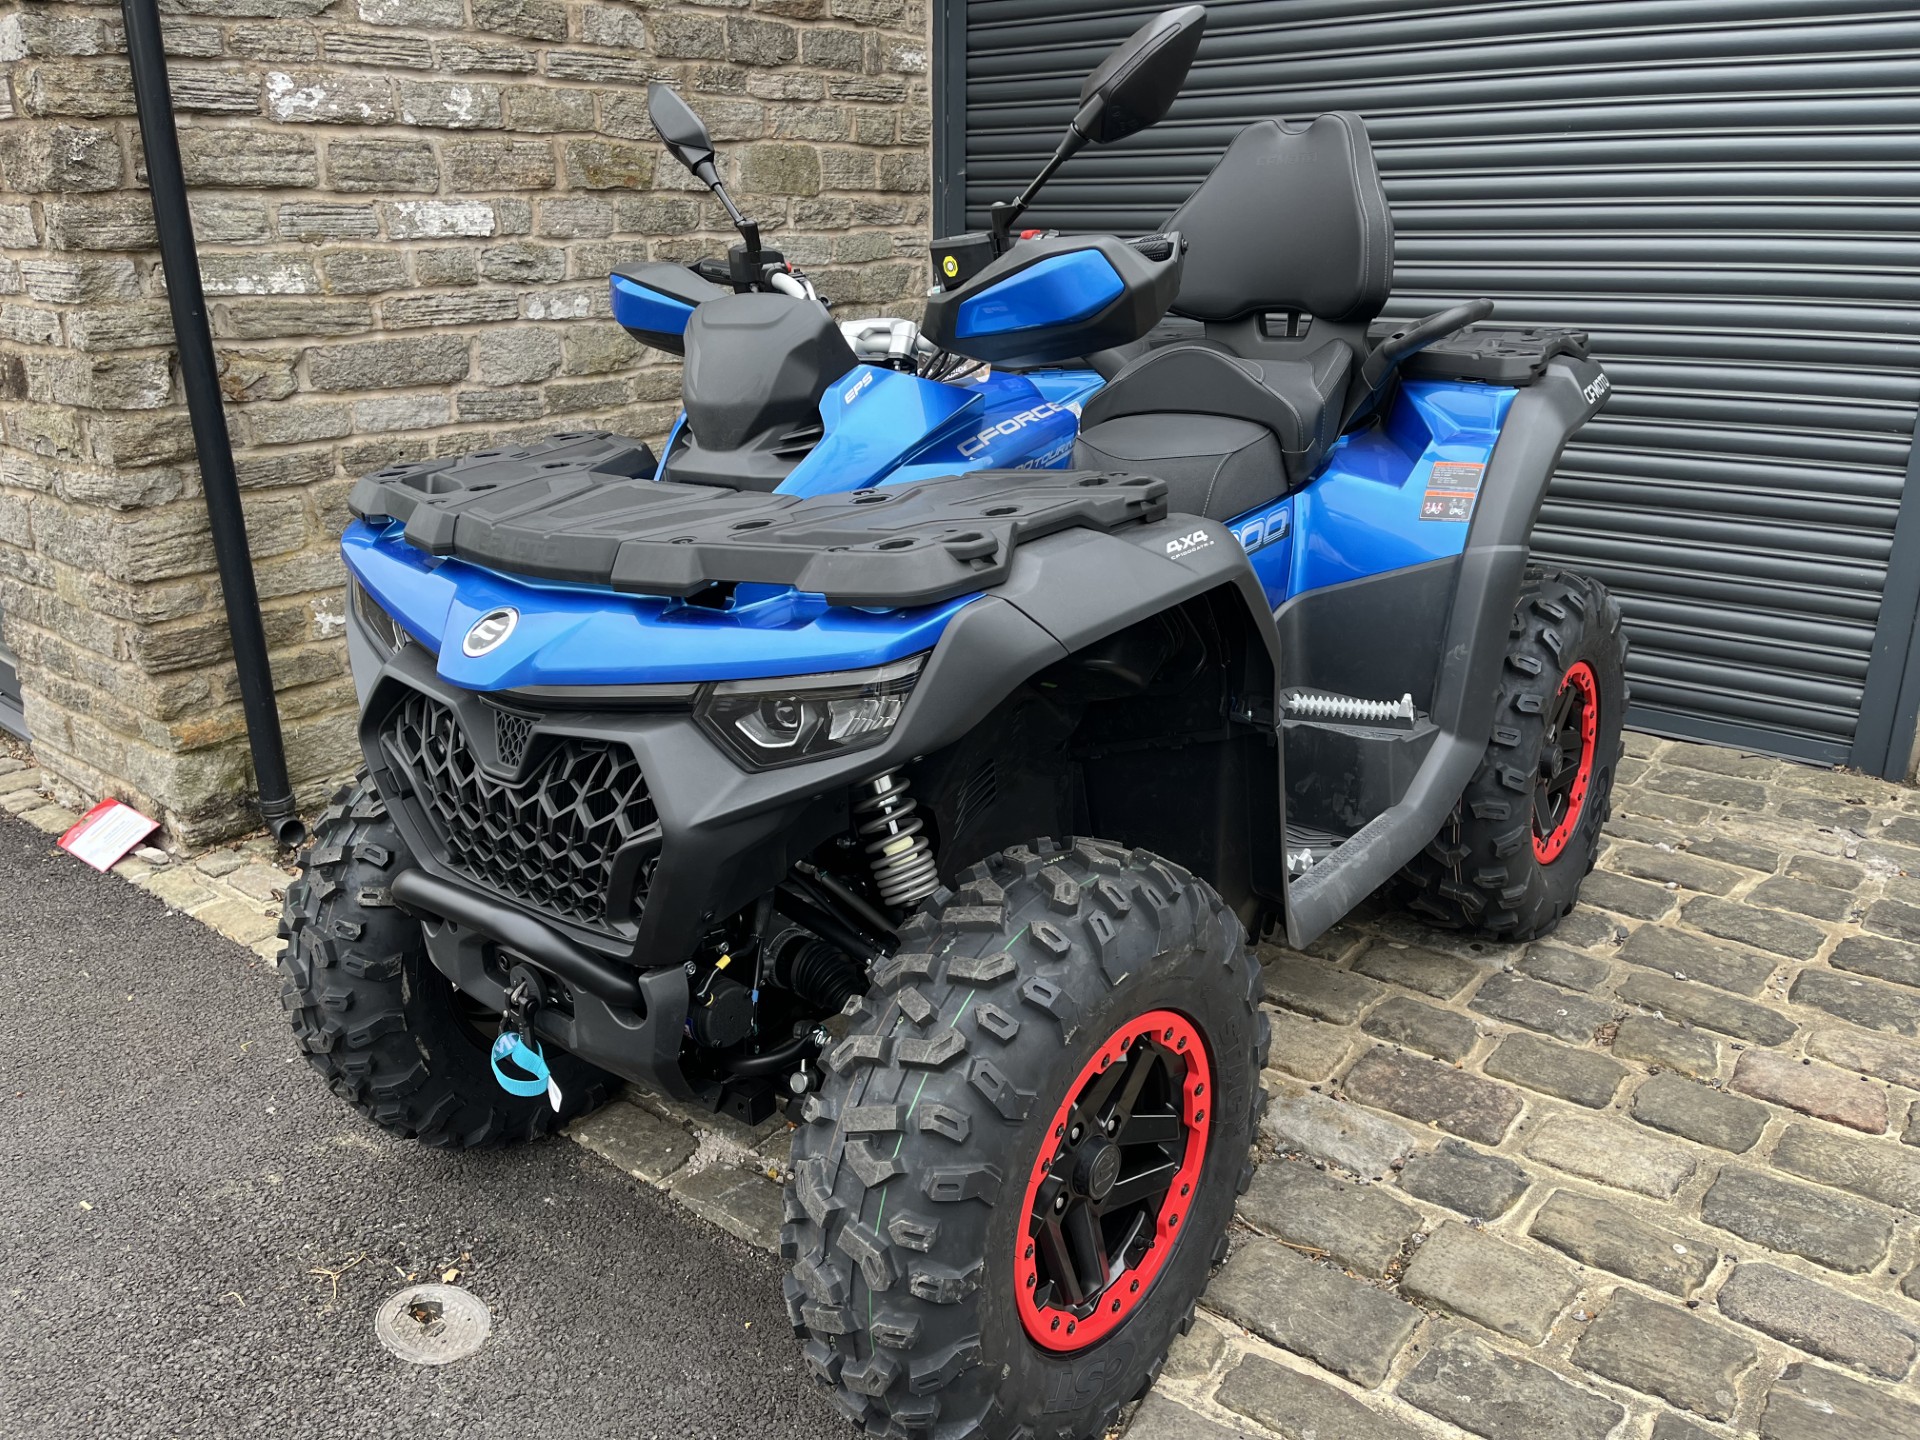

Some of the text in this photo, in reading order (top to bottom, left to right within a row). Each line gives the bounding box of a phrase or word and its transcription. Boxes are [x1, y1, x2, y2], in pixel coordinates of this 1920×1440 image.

[844, 371, 873, 405] EPS
[1583, 372, 1610, 405] CFMOTO
[957, 402, 1066, 457] CFORCE
[1031, 440, 1076, 468] TOURIN
[1166, 530, 1209, 553] 4X4
[1230, 506, 1290, 554] 00
[1043, 1341, 1136, 1414] CST
